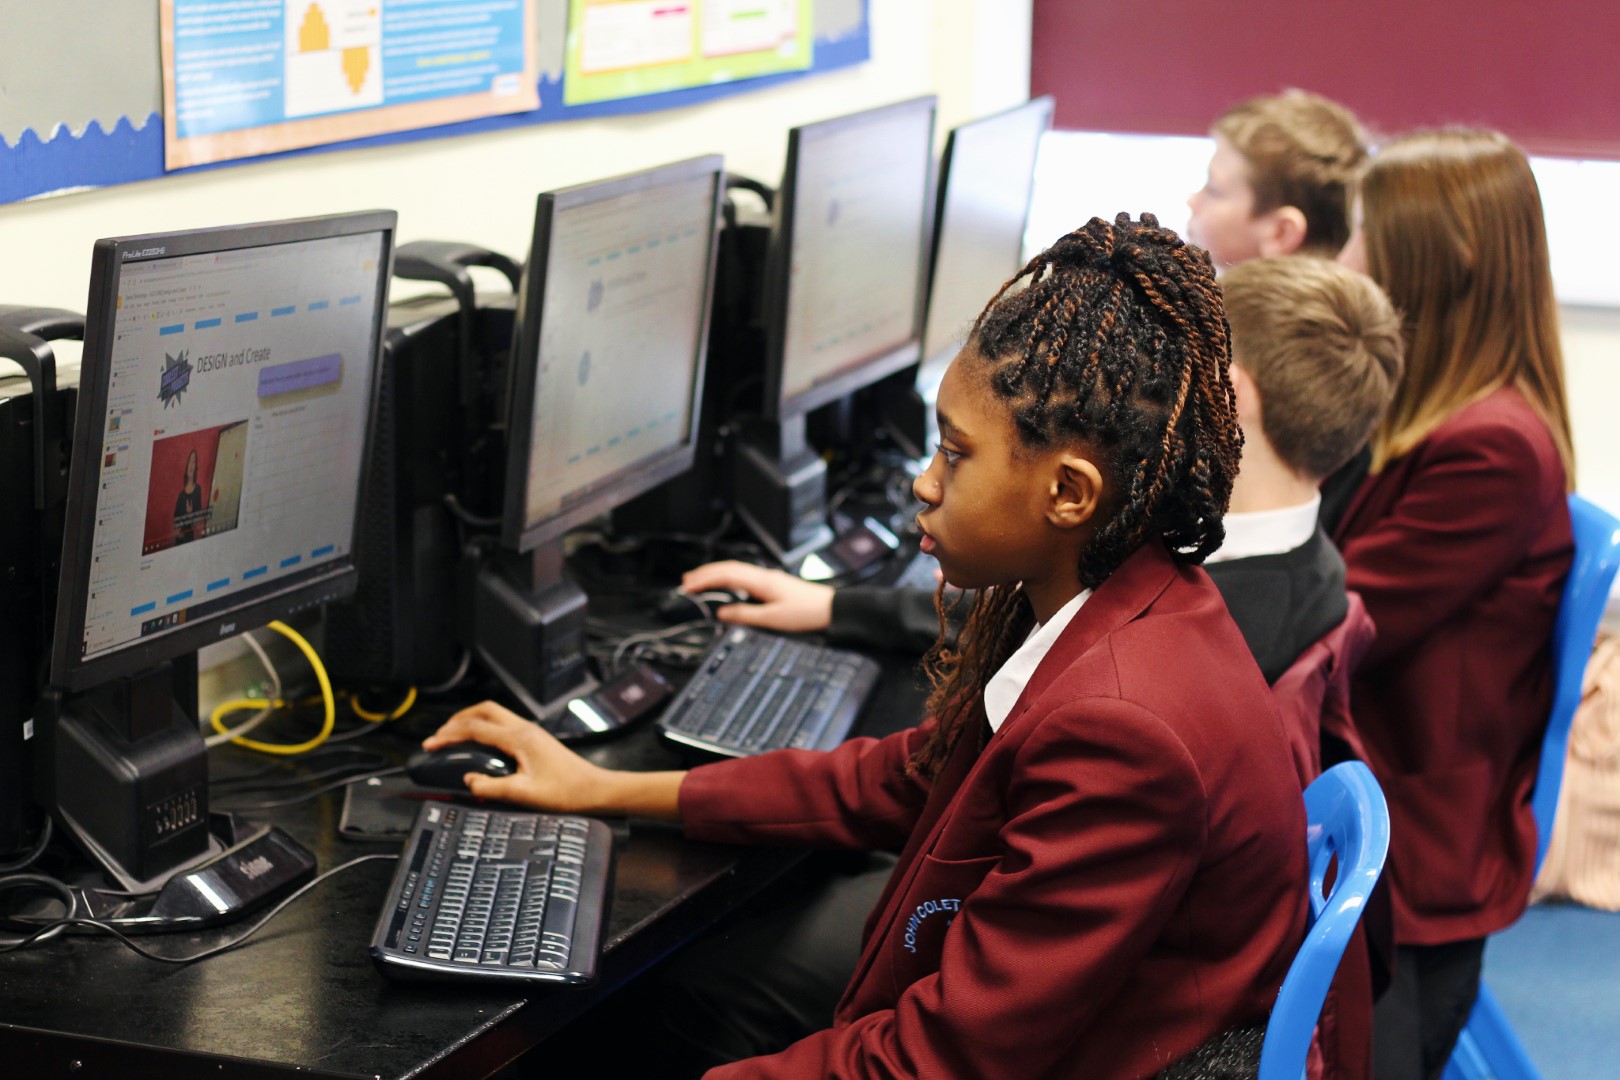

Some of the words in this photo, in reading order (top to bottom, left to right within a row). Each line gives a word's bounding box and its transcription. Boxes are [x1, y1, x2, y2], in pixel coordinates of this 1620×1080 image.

[123, 251, 141, 259] ProLite
[197, 353, 227, 373] DESIGN
[229, 349, 245, 366] and
[246, 348, 271, 364] Create
[904, 914, 921, 953] JOHN
[916, 899, 961, 918] COLET
